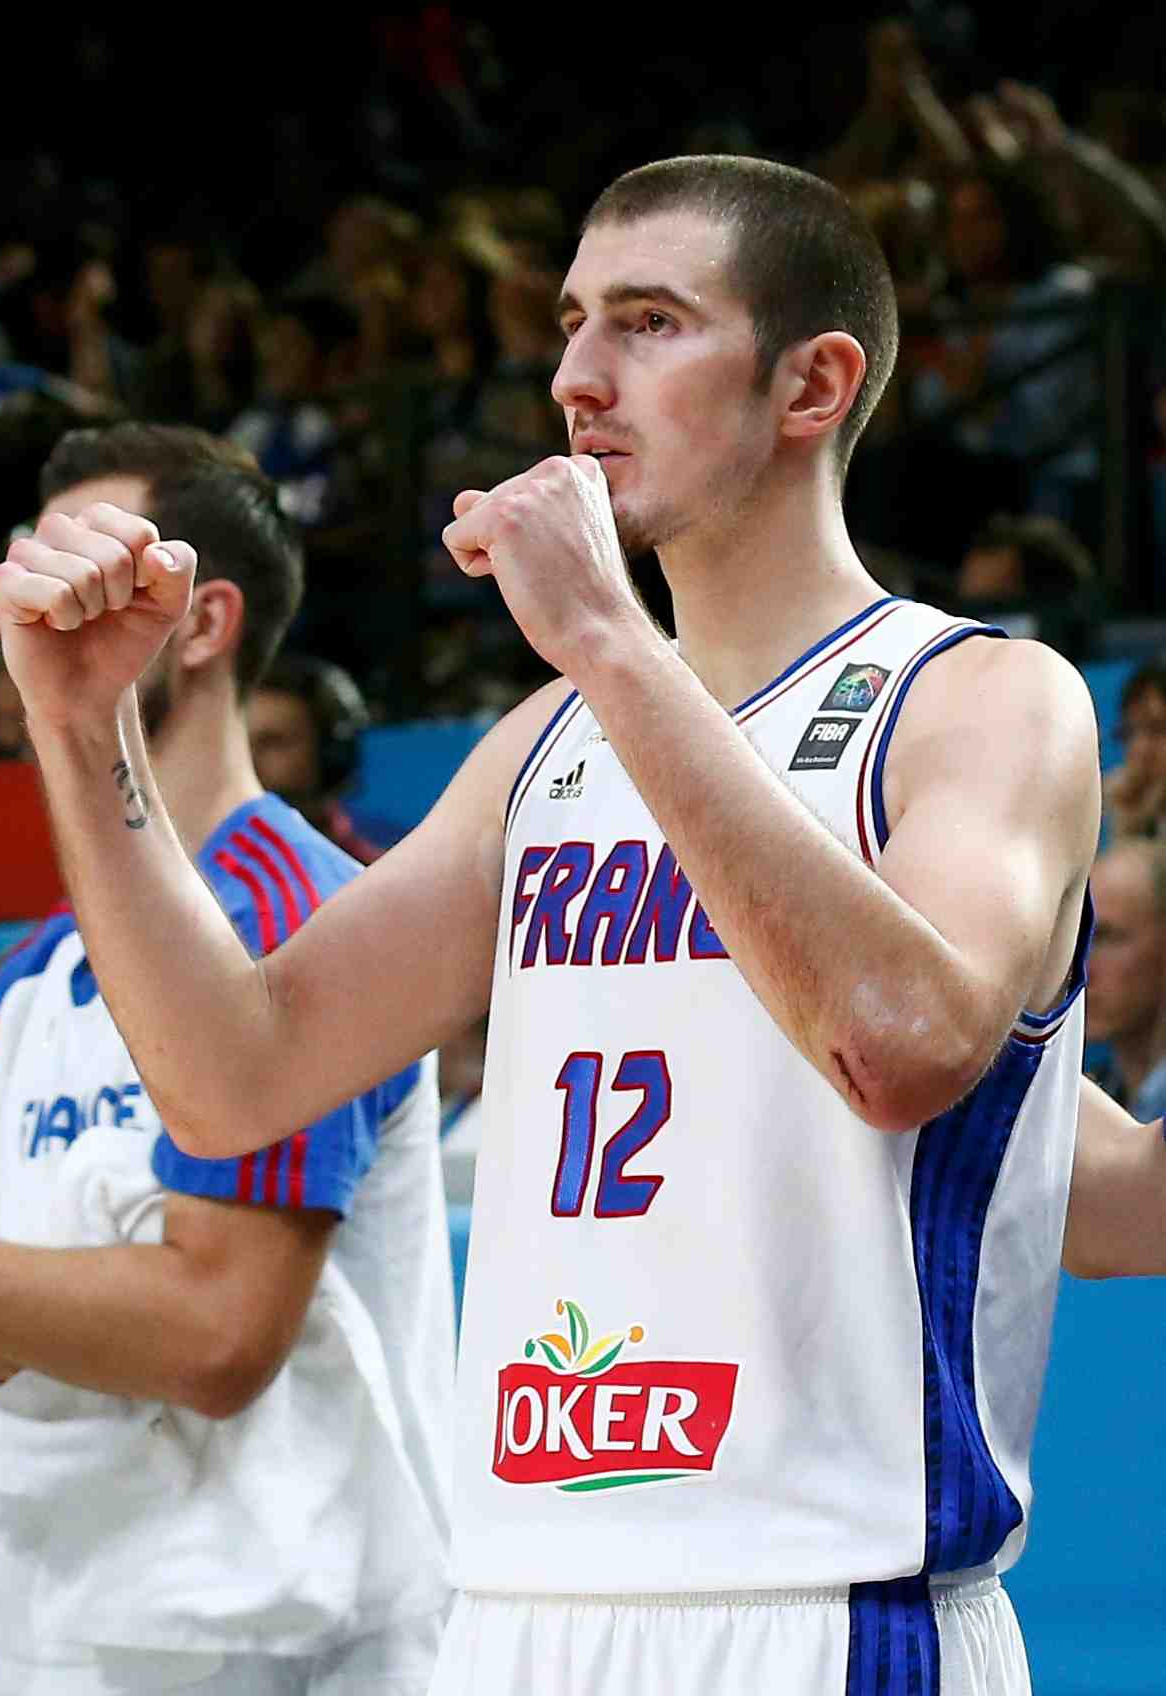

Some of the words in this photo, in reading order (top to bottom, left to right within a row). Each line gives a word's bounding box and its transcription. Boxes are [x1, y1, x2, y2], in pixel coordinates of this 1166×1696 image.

[808, 722, 851, 742] FIBA
[551, 1050, 672, 1218] 12
[497, 1383, 705, 1465] JOKER
